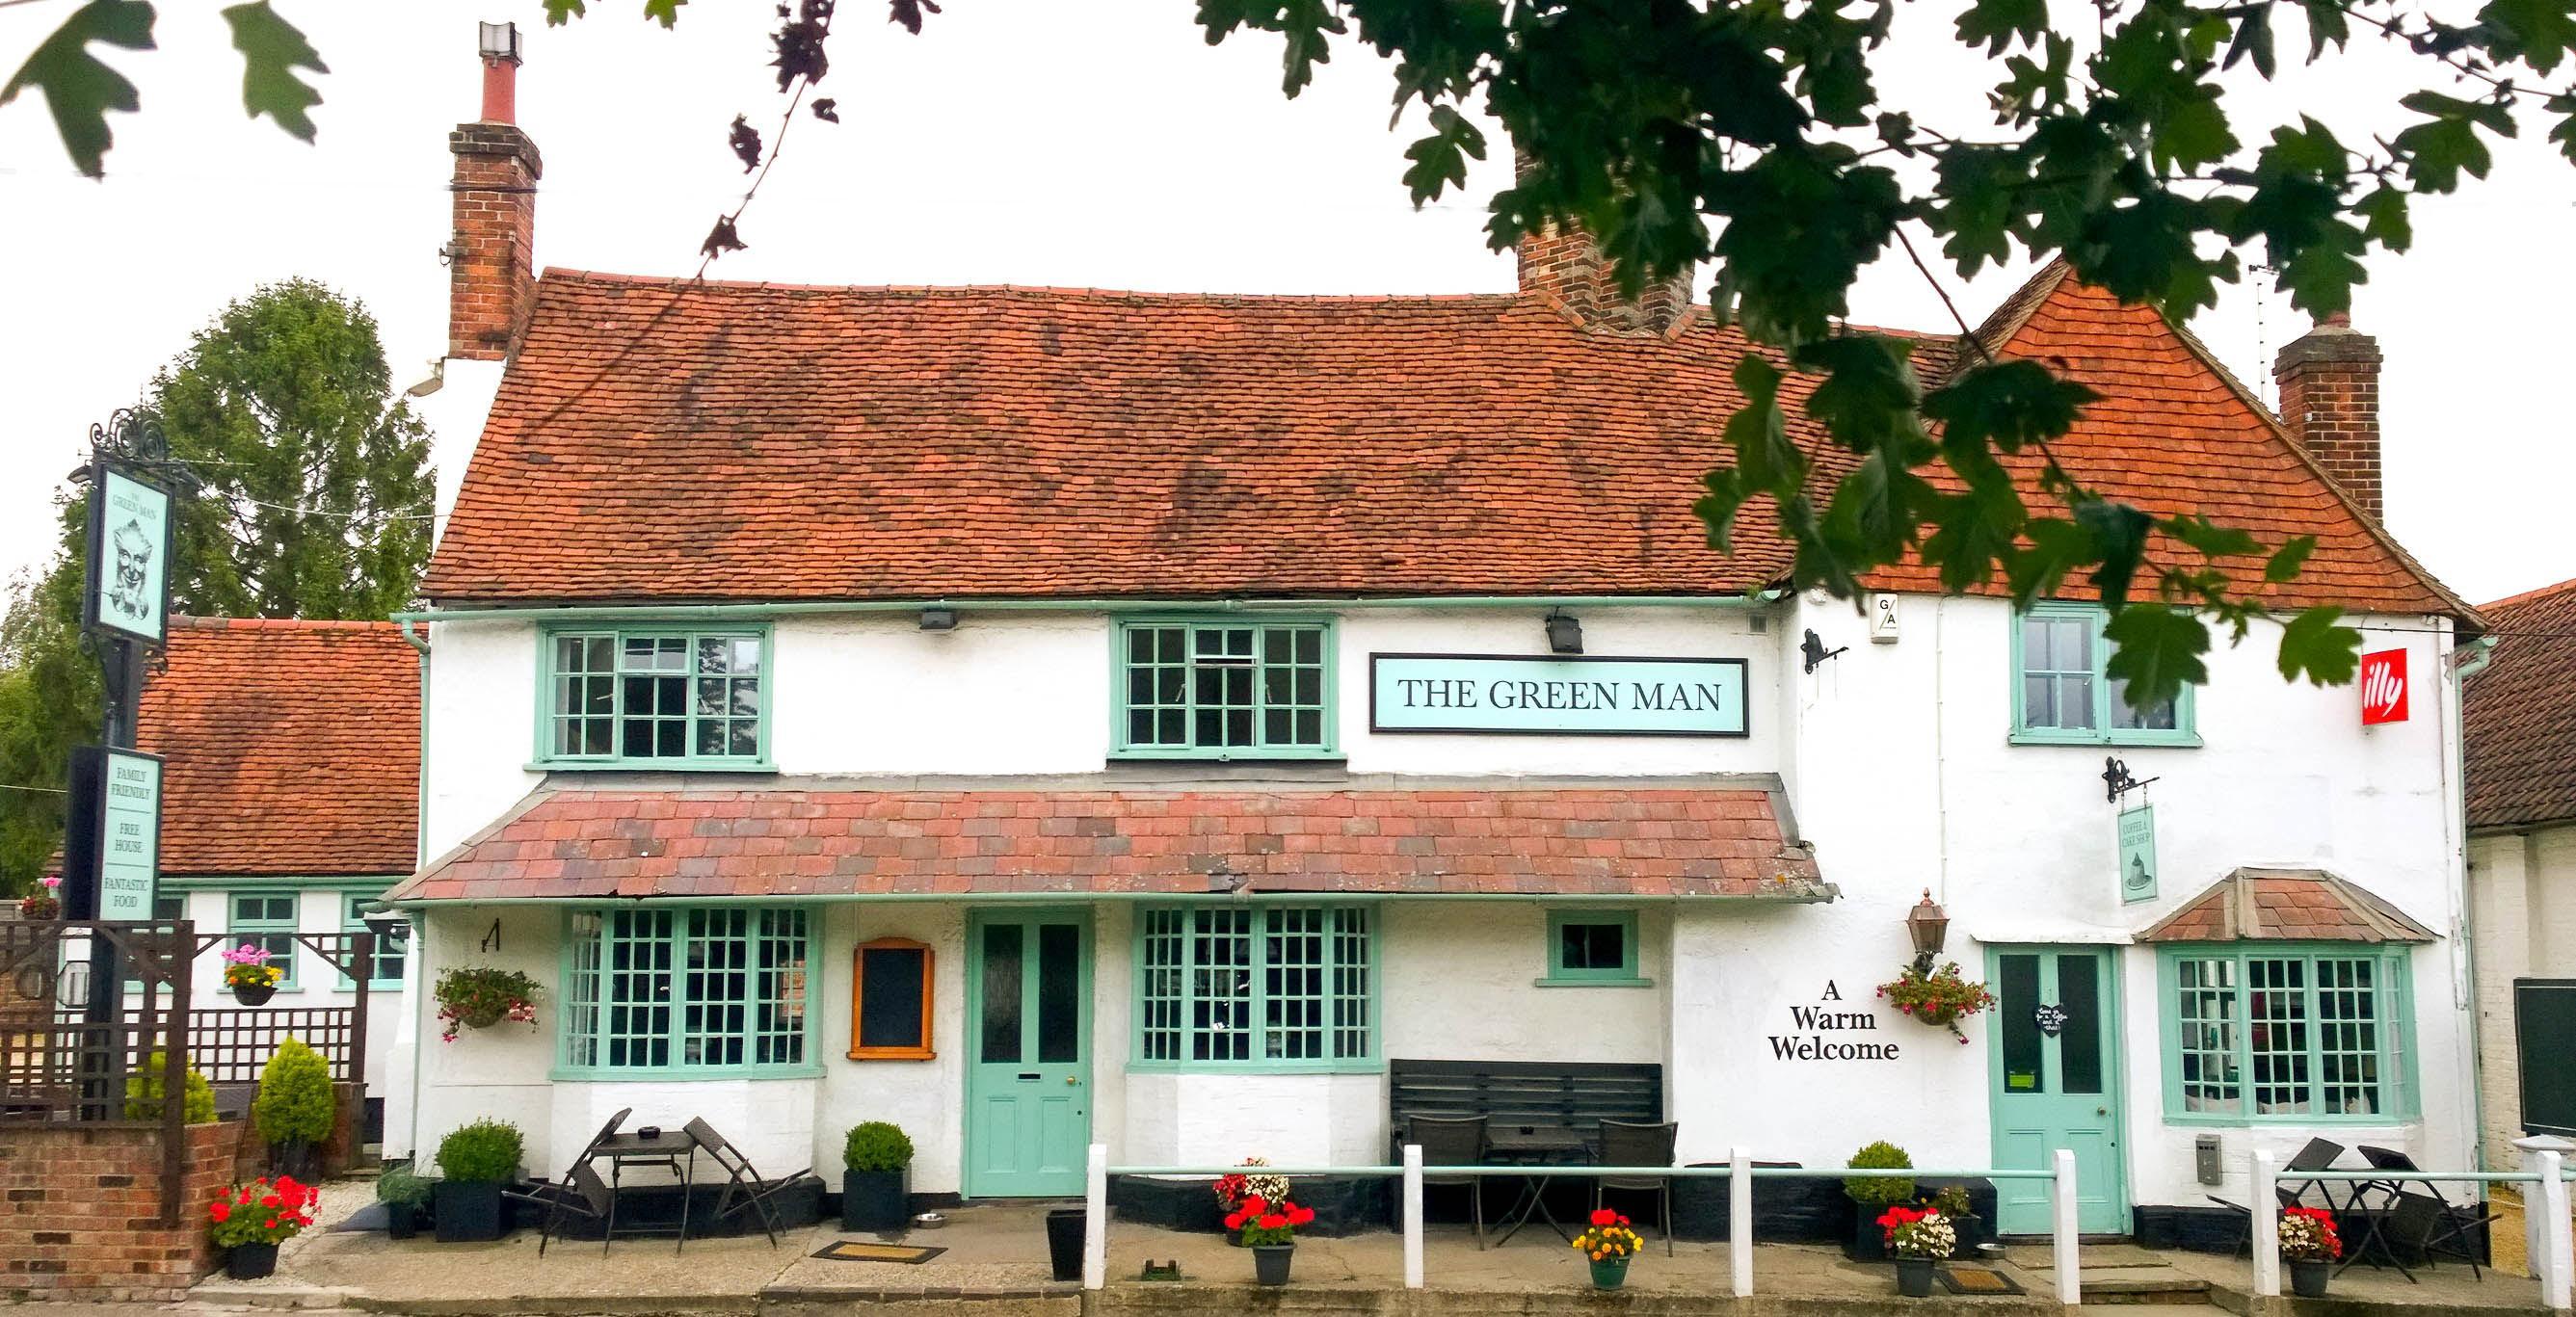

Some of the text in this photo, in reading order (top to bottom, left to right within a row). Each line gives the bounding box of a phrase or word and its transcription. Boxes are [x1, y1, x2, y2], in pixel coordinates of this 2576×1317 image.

[1397, 679, 1722, 712] THE GREEN MAN
[2364, 661, 2403, 718] illy
[117, 767, 147, 783] FAMILY
[111, 783, 151, 801] FRIENDLY
[120, 823, 141, 836] FREE
[115, 839, 144, 854] HOUSE
[104, 877, 148, 892] FANTASTIC
[114, 895, 138, 908] FOOD
[1821, 979, 1843, 1001] A
[1790, 1006, 1877, 1031] Warm
[1767, 1036, 1899, 1061] Welcome
